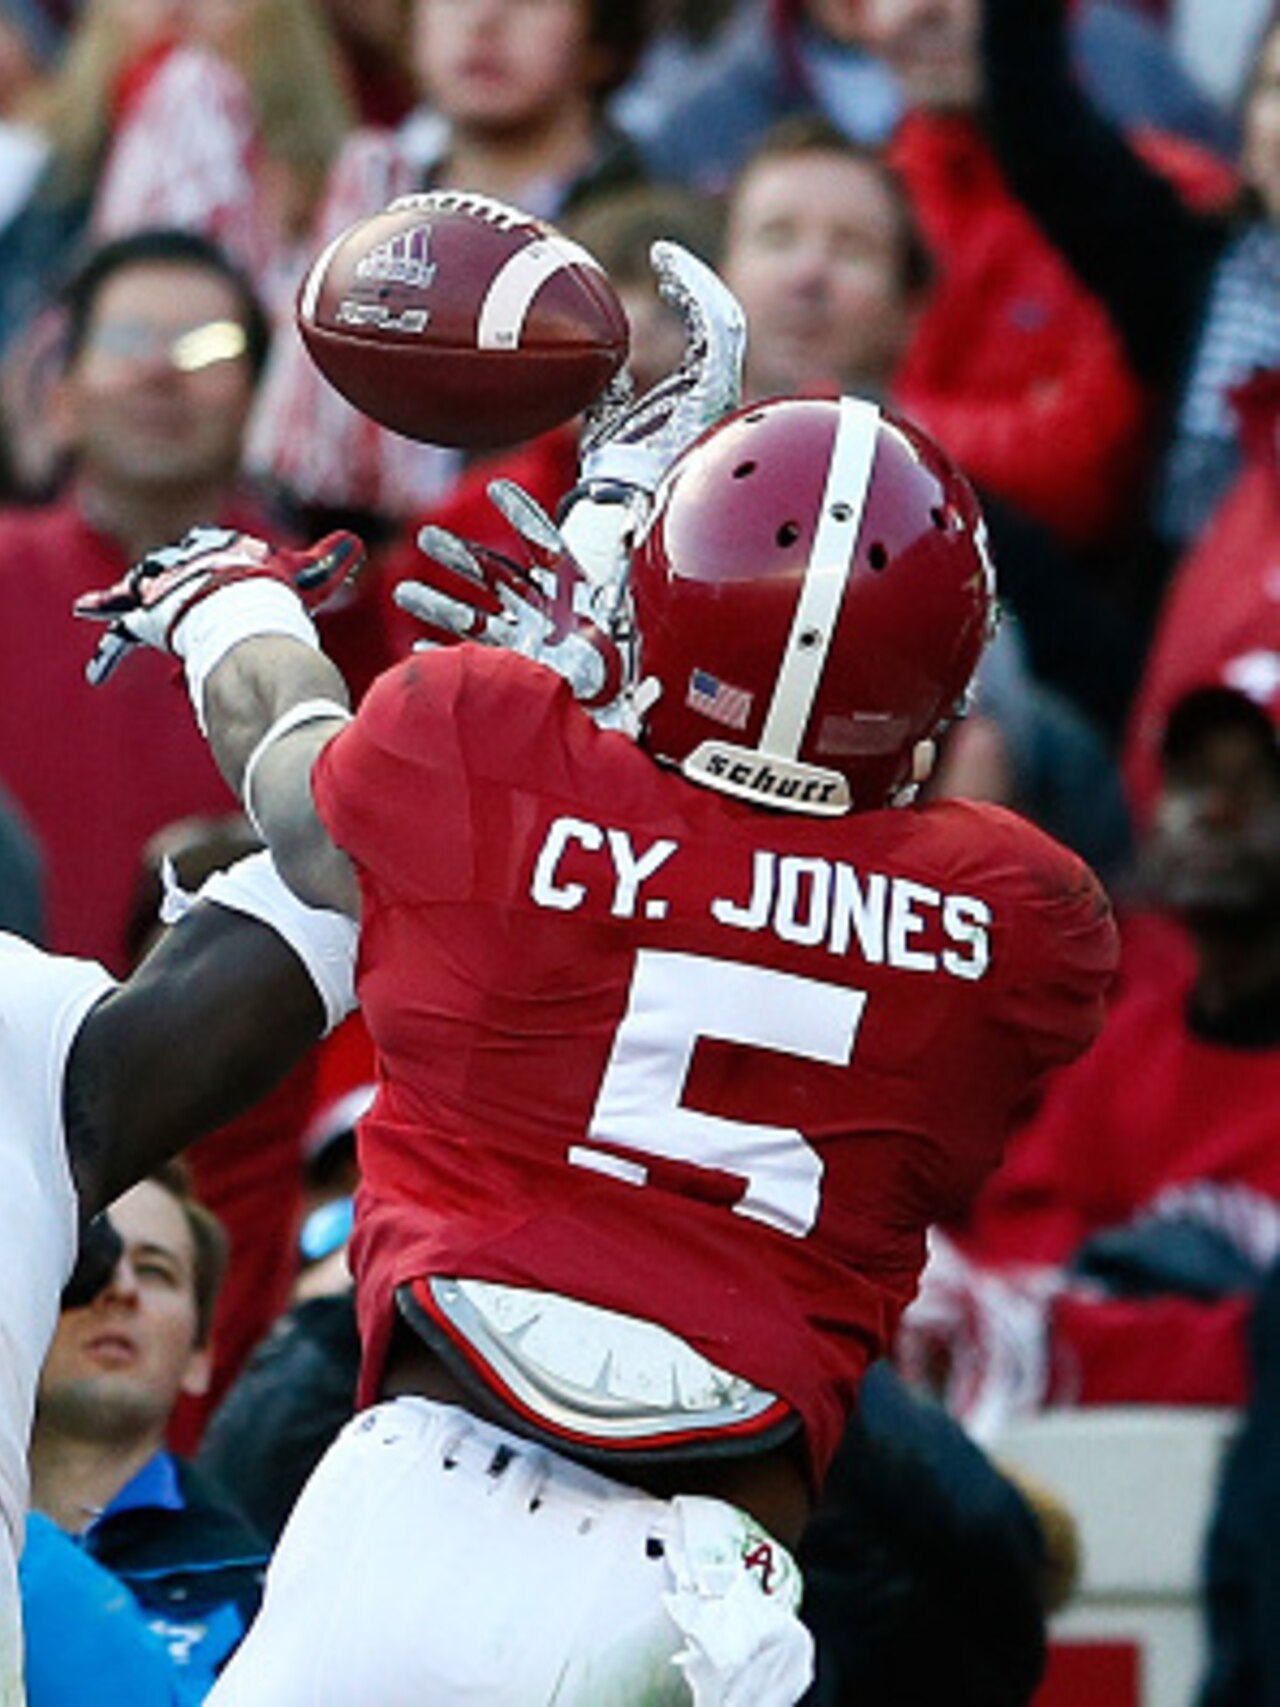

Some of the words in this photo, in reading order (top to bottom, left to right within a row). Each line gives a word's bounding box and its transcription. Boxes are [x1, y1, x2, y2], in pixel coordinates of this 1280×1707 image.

[530, 816, 678, 919] CY.
[711, 851, 991, 980] JONES
[568, 949, 867, 1238] 5
